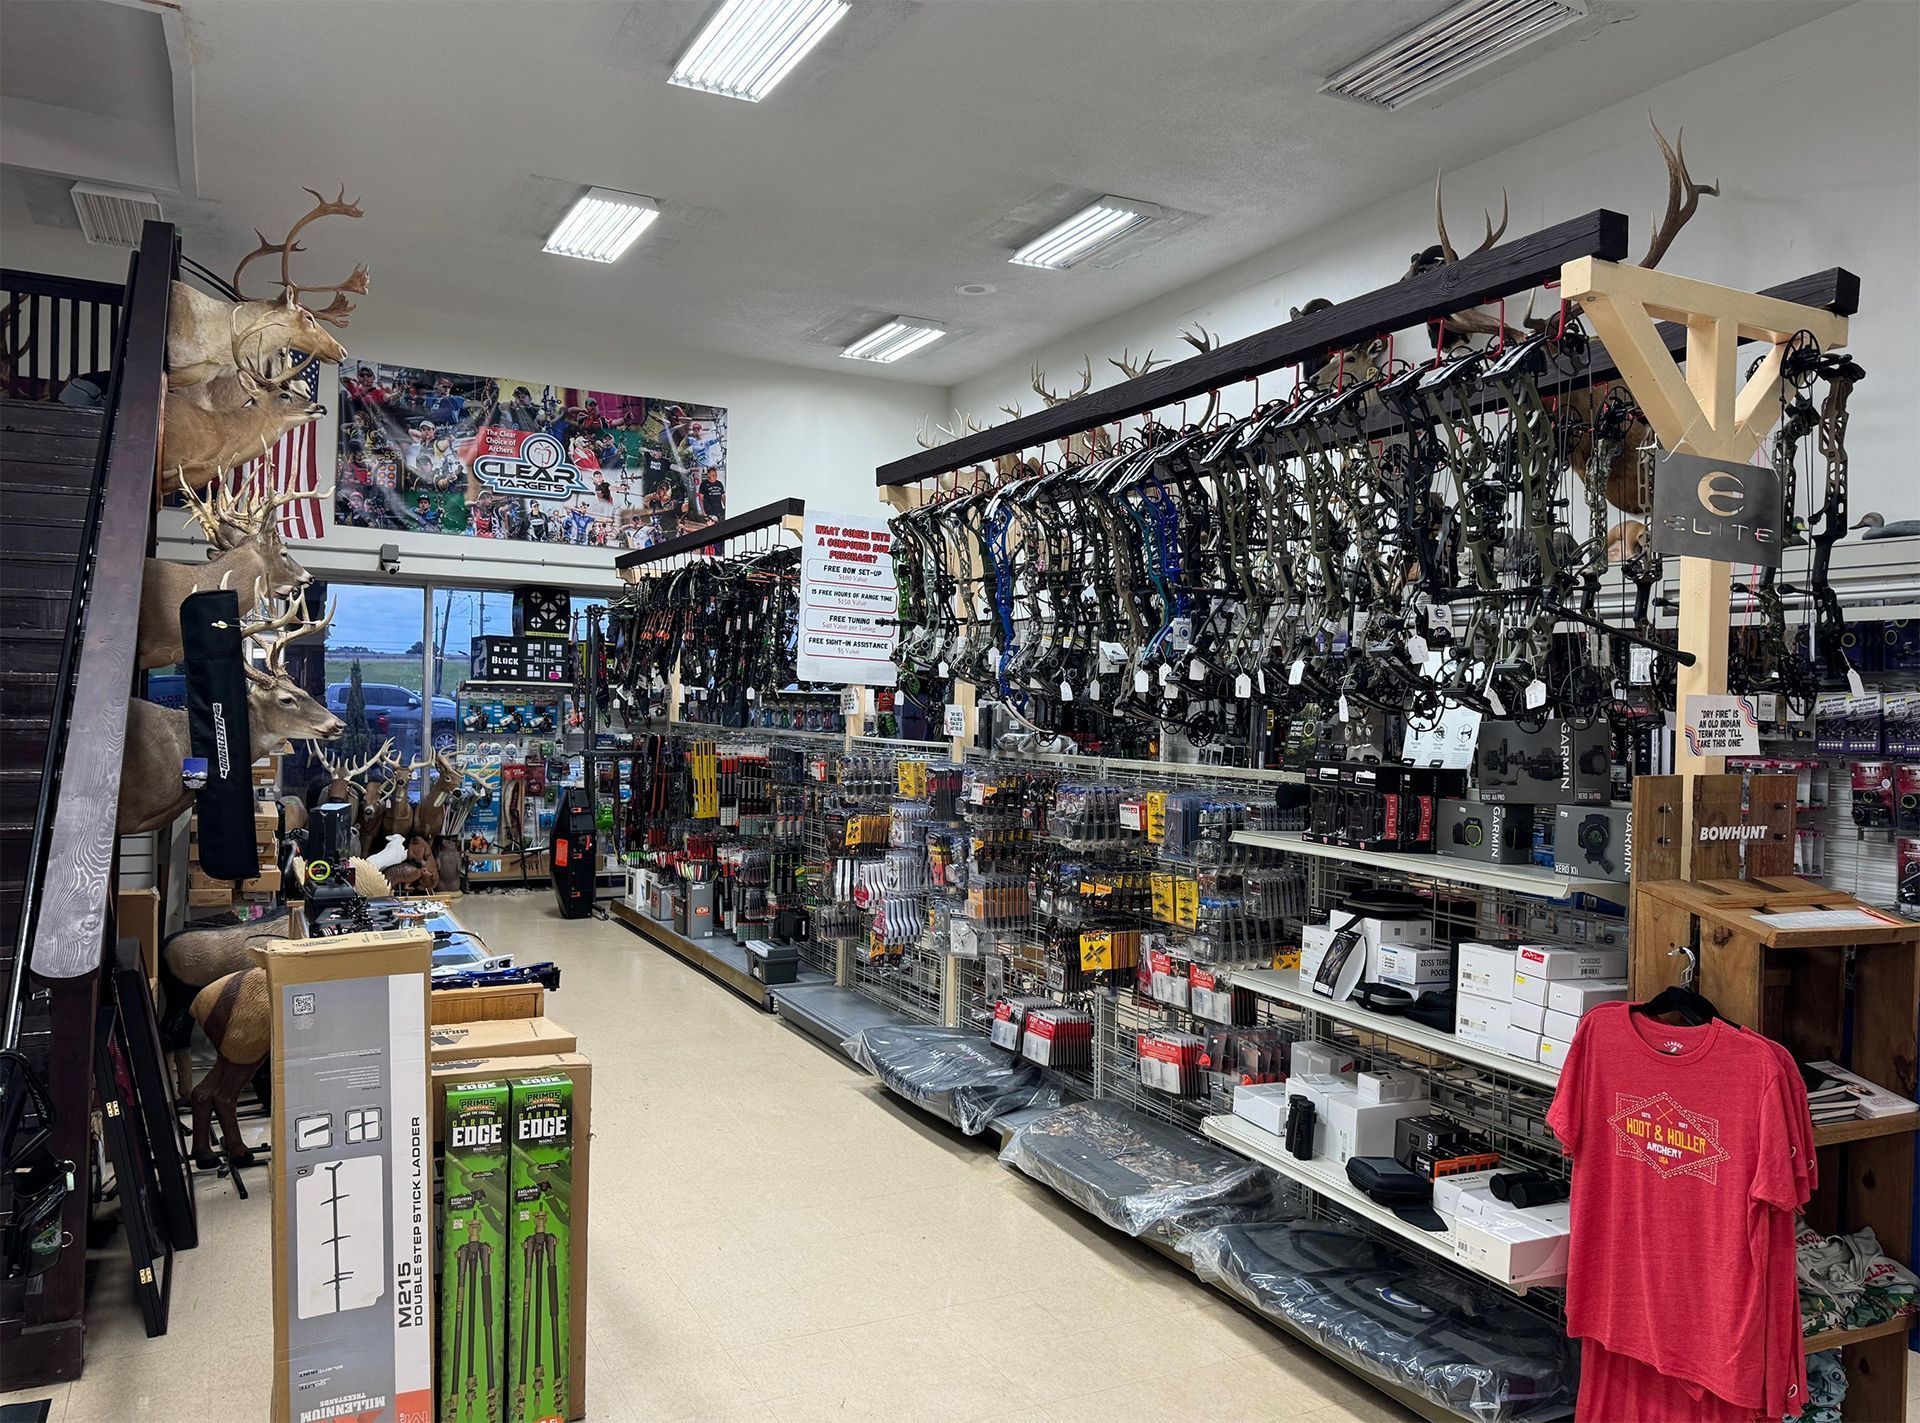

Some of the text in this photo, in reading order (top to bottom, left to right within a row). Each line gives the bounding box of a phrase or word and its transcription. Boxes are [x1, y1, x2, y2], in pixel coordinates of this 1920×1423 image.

[486, 429, 498, 437] The
[486, 437, 507, 446] Choice
[488, 445, 513, 454] Archers
[480, 461, 576, 484] CLEAR
[497, 478, 565, 492] TARGETS
[815, 525, 891, 543] WHAT COMES WITH
[1663, 515, 1774, 543] ELITE
[818, 537, 825, 546] A
[827, 538, 871, 552] COMPOUND
[829, 551, 878, 564] PURCHASE?
[823, 565, 882, 577] FREE BOW SET-UP
[818, 589, 832, 597] FREE
[834, 590, 851, 598] HOURS
[853, 591, 860, 599] OF
[861, 593, 879, 601] RANGE
[880, 594, 893, 602] TIME
[829, 615, 871, 625] FREE TUNING
[833, 623, 847, 631] Value
[808, 637, 888, 650] FREE SIGHT-IN ASSISTANCE
[1733, 710, 1739, 719] IS
[1699, 719, 1741, 728] AN OLD INDIAN
[1698, 730, 1713, 739] TERM
[1714, 729, 1726, 738] FOR
[1697, 739, 1711, 748] TAKE
[1713, 738, 1726, 748] THIS
[1560, 722, 1571, 791] GARMIN
[1492, 806, 1501, 859] GARMIN
[1700, 825, 1768, 841] BOWHUNT
[1624, 812, 1633, 875] GARMIN
[1555, 864, 1569, 874] XERO
[1420, 959, 1434, 967] ZEISS
[1664, 1041, 1683, 1049] LEAGUE
[527, 1091, 561, 1101] PRIMOS
[461, 1099, 496, 1110] PRIMOS
[519, 1109, 567, 1120] CARBON
[452, 1116, 503, 1127] CARBON
[519, 1117, 567, 1140] EDGE
[452, 1124, 502, 1147] EDGE
[1626, 1117, 1706, 1156] HOOT & HOLLER
[1647, 1142, 1683, 1159] ARCHERY
[1658, 1157, 1669, 1165] USA
[411, 1116, 423, 1326] DOUBLE STEP STICK LADDER
[398, 1262, 411, 1328] M215
[320, 1392, 366, 1407] TREESTANDS
[300, 1396, 386, 1423] MILLENNIUM
